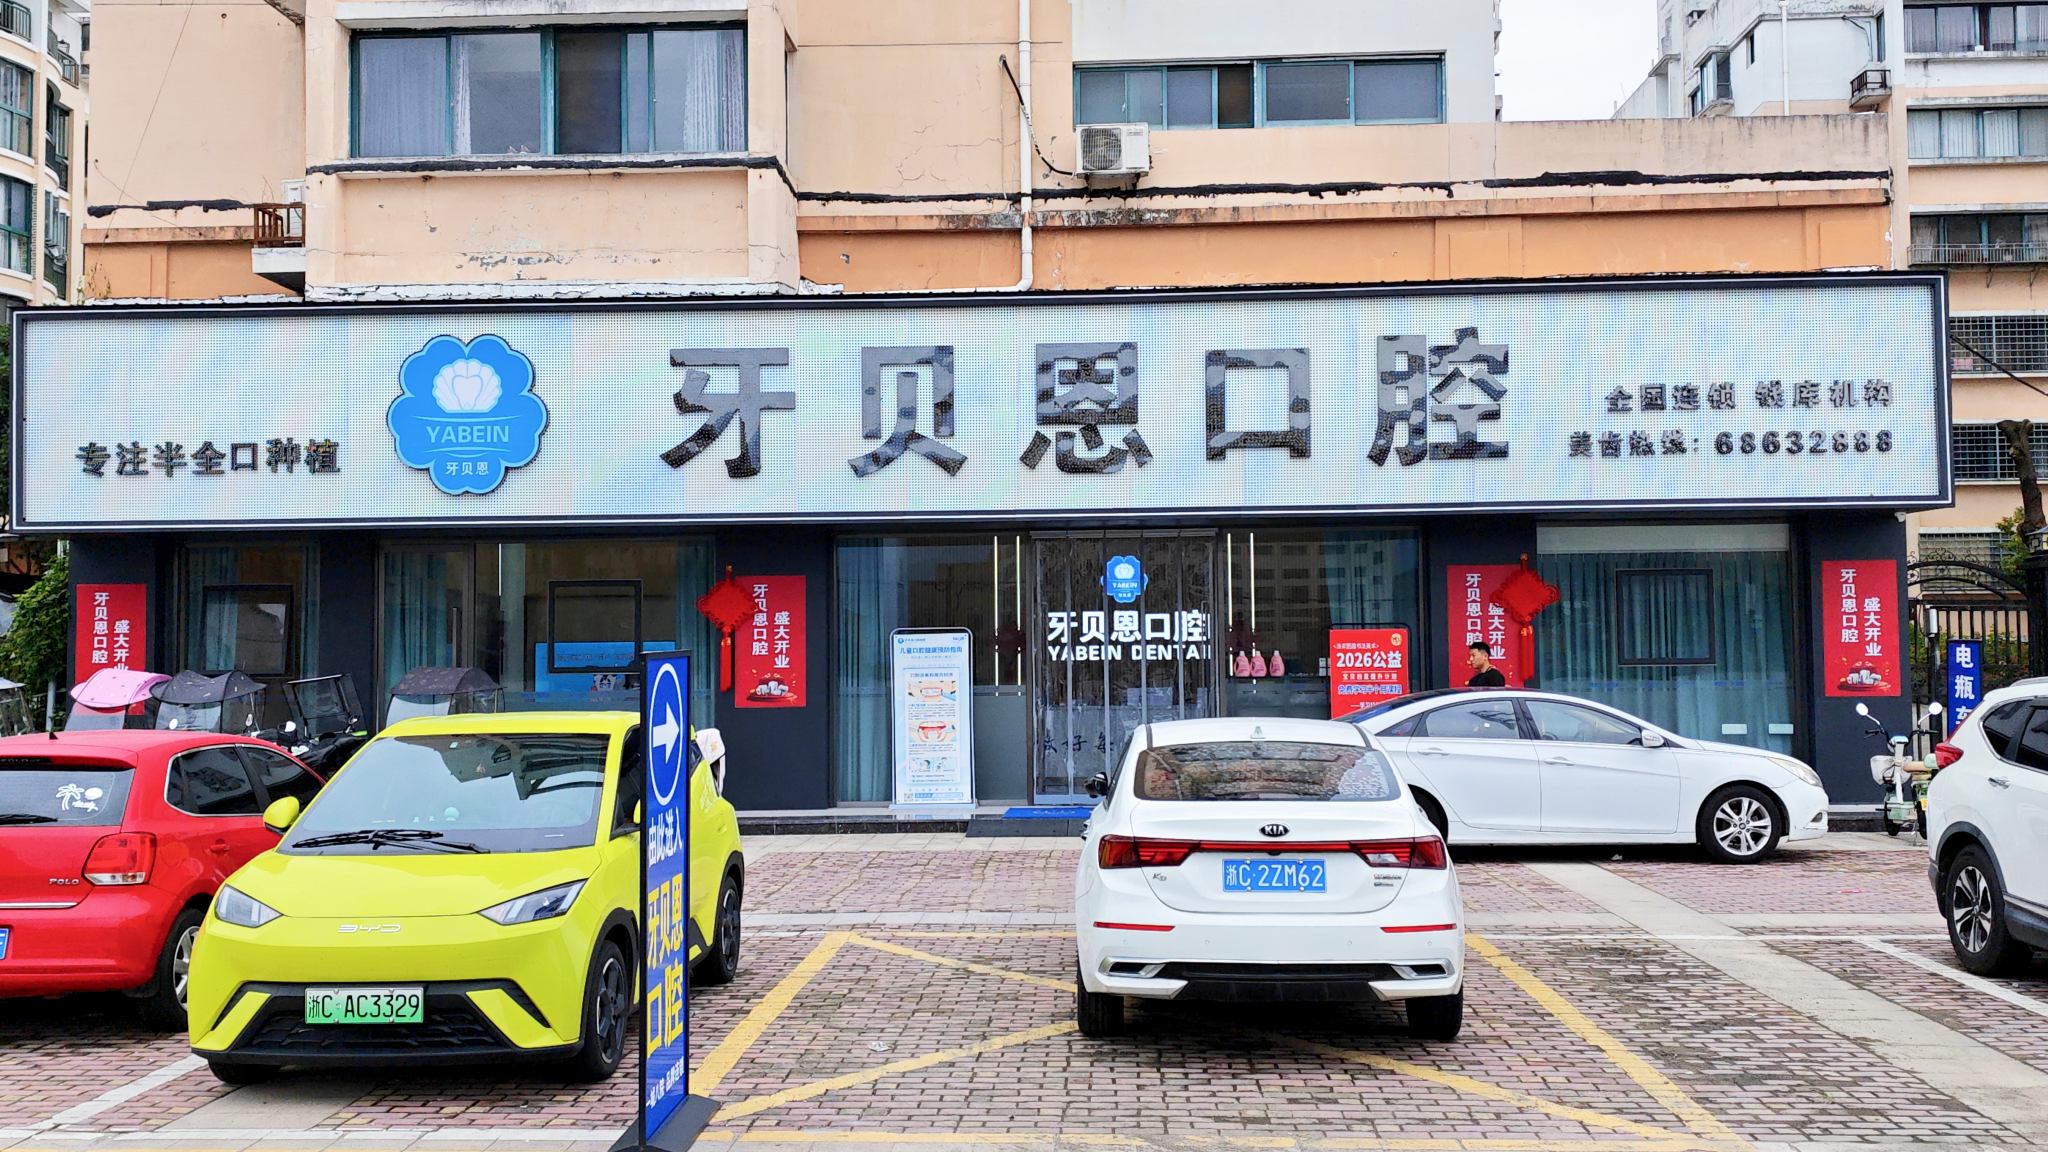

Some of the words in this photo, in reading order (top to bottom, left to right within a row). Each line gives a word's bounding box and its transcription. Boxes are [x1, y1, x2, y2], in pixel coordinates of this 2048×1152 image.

[659, 326, 1509, 480] 牙贝恩口腔
[1605, 383, 1736, 412] 全国连锁
[76, 438, 341, 477] 专注半全口种植
[425, 425, 509, 444] YABEIN
[445, 461, 489, 476] 牙贝恩
[92, 592, 110, 664] 牙贝恩口腔
[752, 584, 769, 656] 牙贝恩口腔
[1047, 609, 1211, 644] 牙贝恩口腔
[1465, 573, 1483, 646] 牙贝恩口腔
[1488, 602, 1506, 660] 盛大开业
[1840, 569, 1859, 643] 牙贝恩口腔
[1863, 597, 1882, 657] 盛大开业
[773, 611, 790, 669] 盛大开业
[1048, 645, 1122, 661] YABEIN
[1336, 651, 1402, 668] 2026公益
[649, 806, 683, 868] 由此进入
[1264, 824, 1286, 835] KIA
[337, 923, 401, 933] BYD
[648, 872, 683, 966] 牙贝恩
[647, 962, 683, 1057] 口腔
